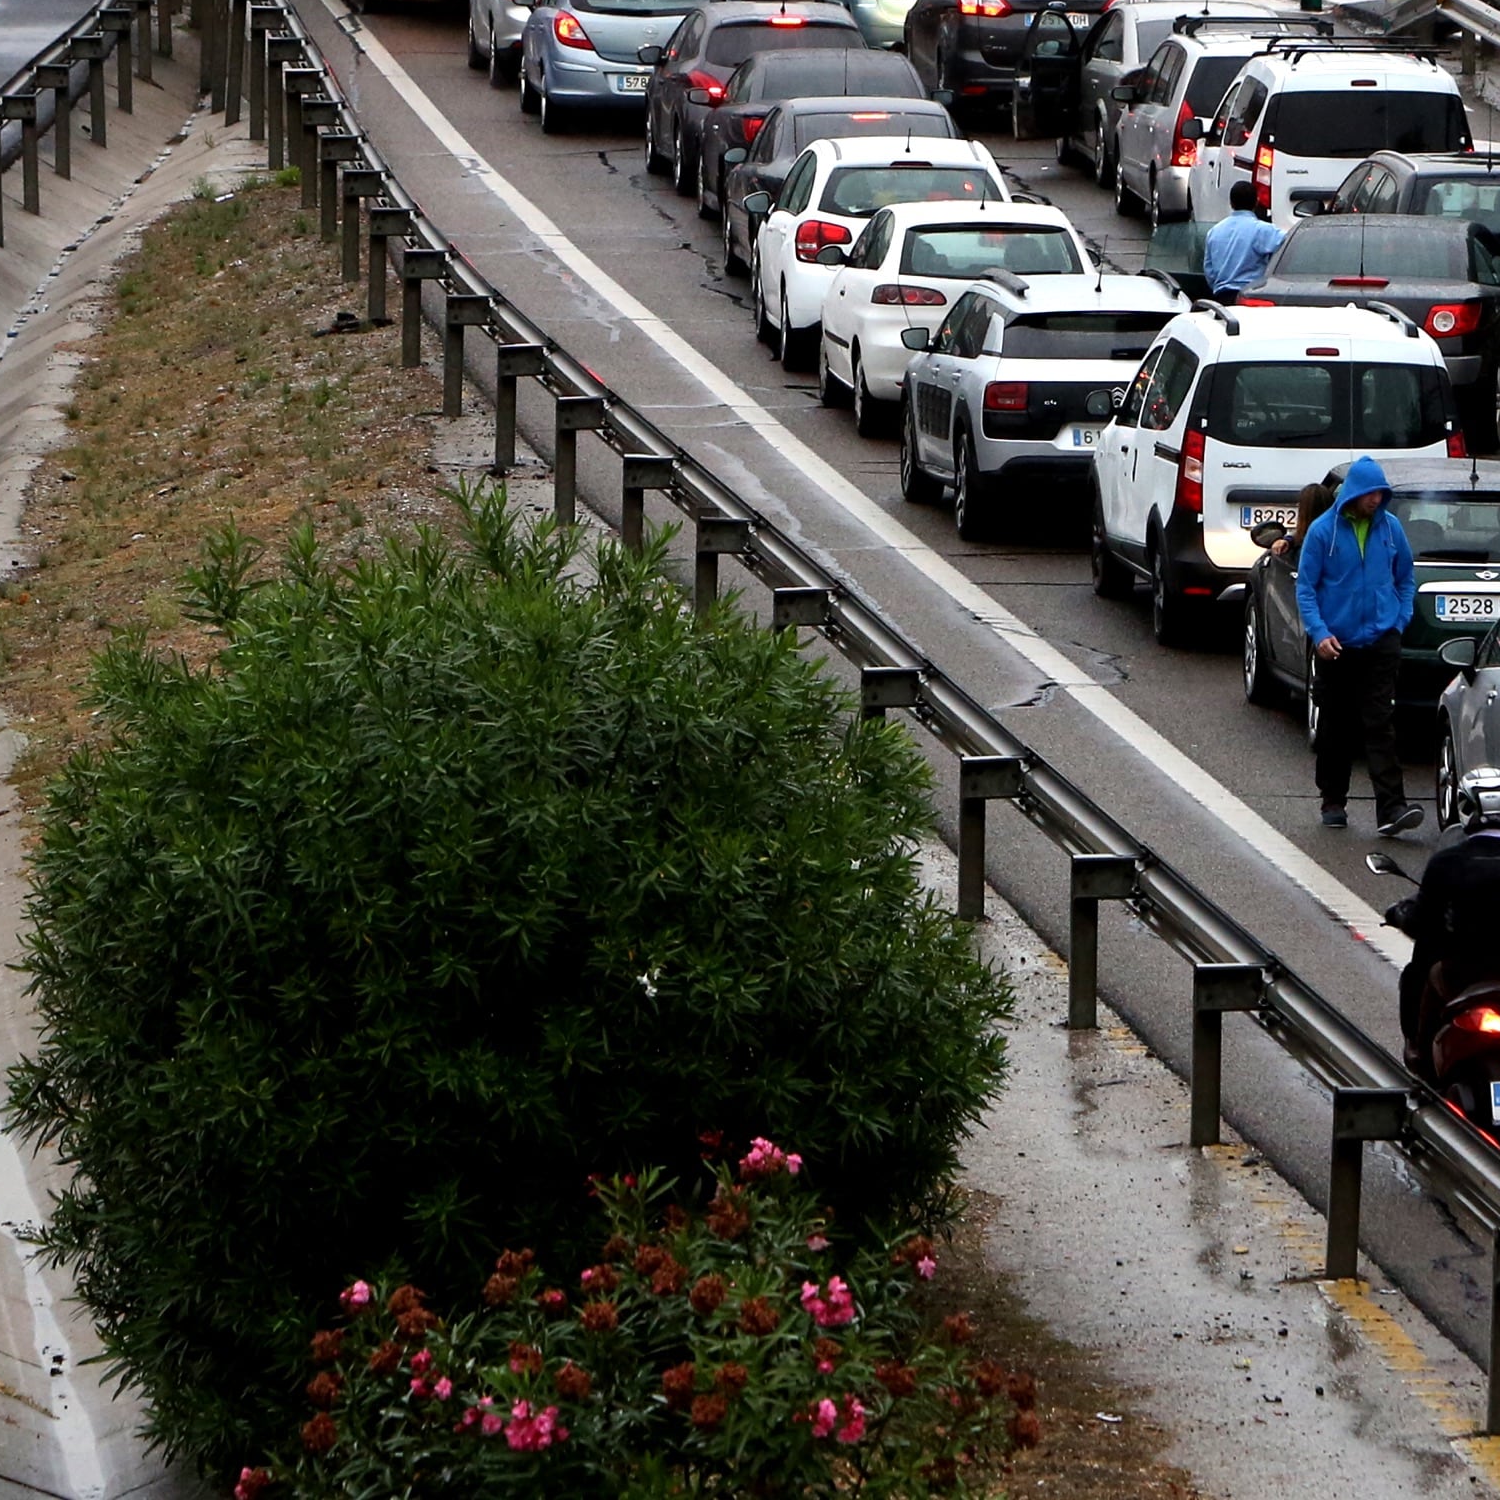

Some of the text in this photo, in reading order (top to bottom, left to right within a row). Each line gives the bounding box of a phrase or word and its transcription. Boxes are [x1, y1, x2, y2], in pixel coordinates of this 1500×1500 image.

[1222, 461, 1252, 469] DACIA
[1254, 509, 1297, 526] 8262
[1449, 598, 1493, 615] 2528
